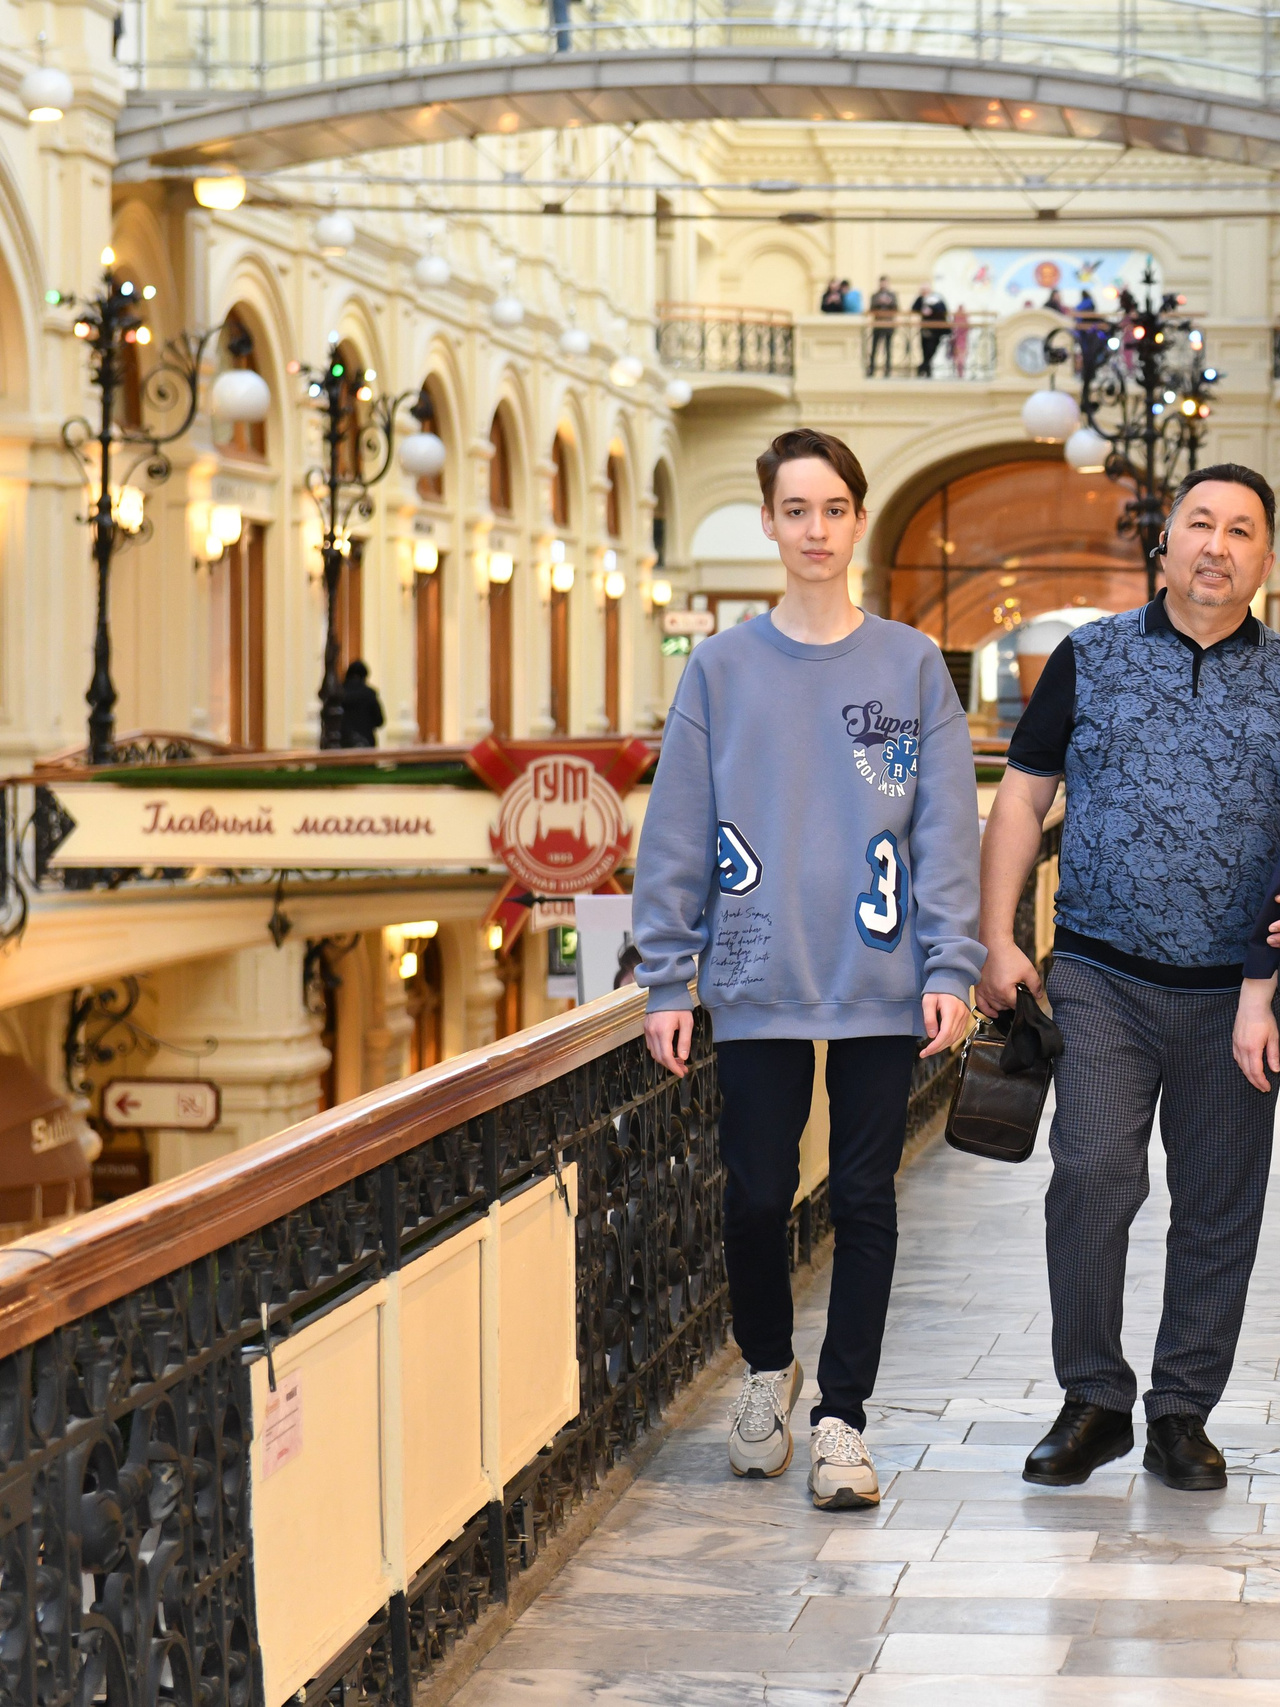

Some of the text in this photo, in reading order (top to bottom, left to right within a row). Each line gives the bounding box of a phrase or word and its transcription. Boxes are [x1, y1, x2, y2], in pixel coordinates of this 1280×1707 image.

[841, 700, 919, 738] Super
[533, 760, 589, 805] ГУМ
[853, 748, 906, 797] NEW YORK
[142, 800, 435, 836] Главный магазин
[857, 834, 905, 947] 3
